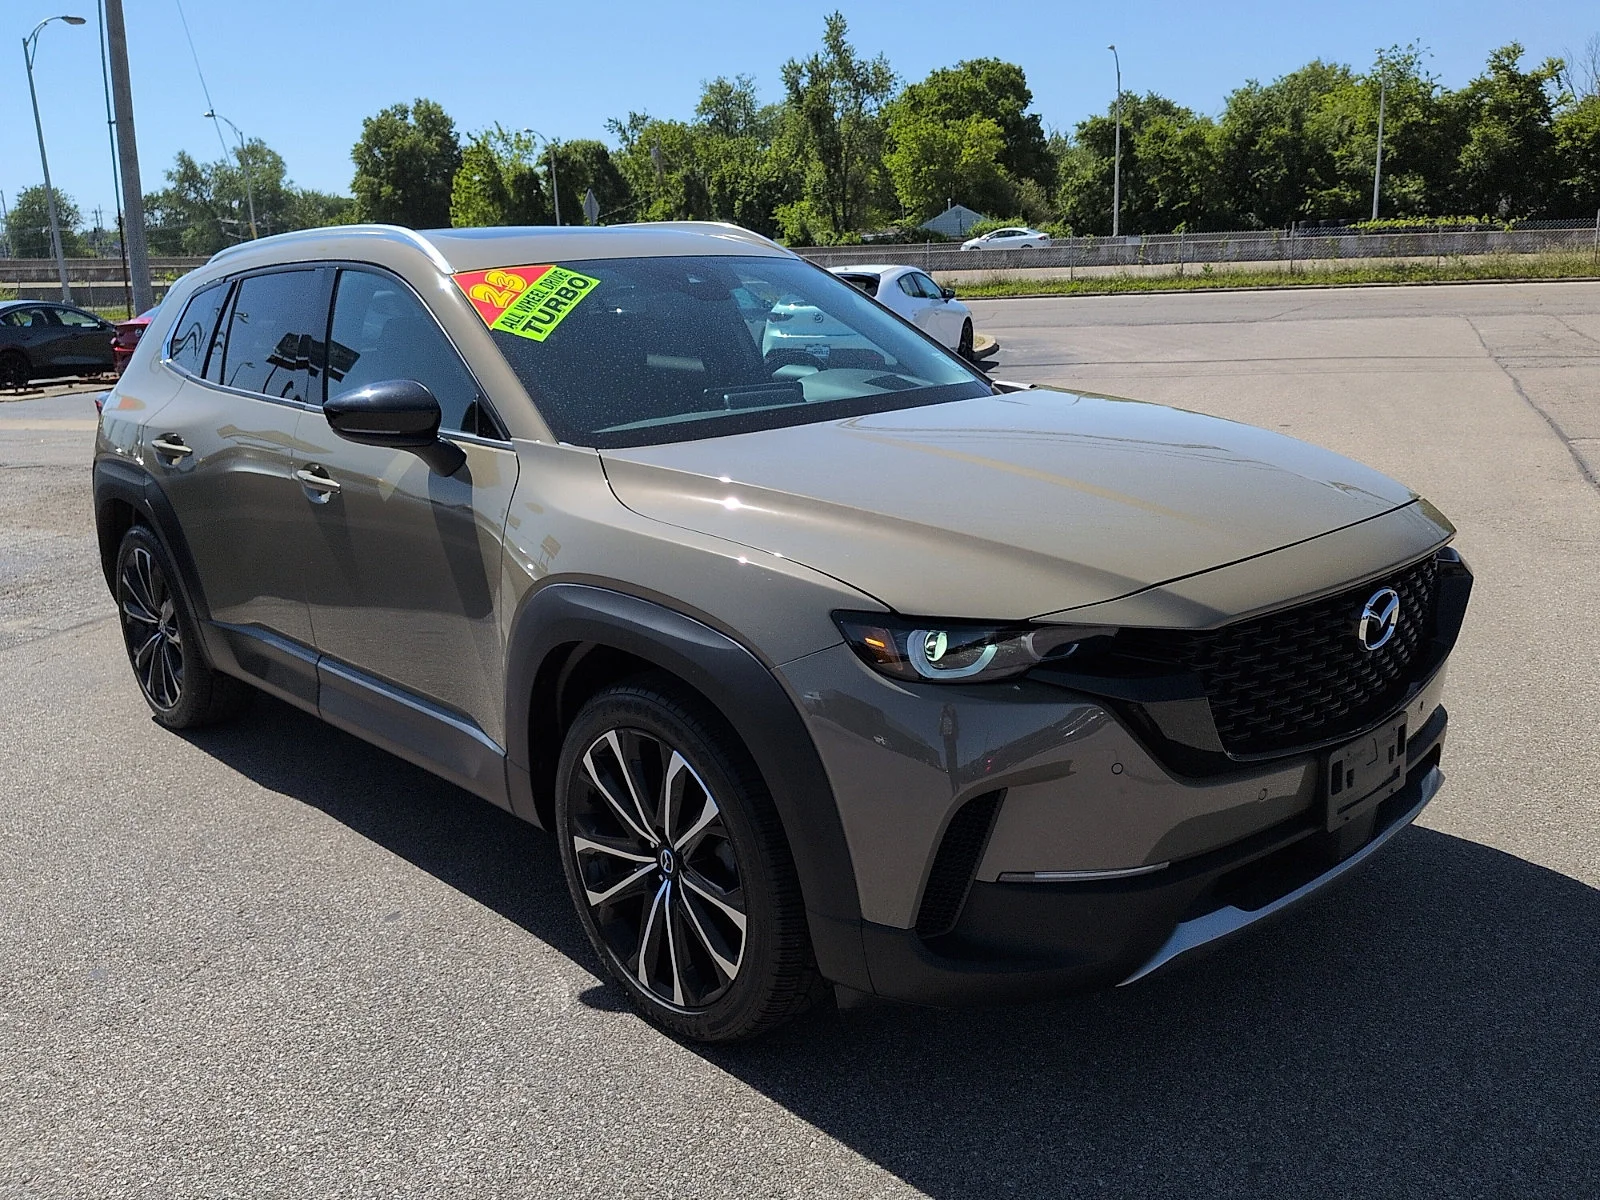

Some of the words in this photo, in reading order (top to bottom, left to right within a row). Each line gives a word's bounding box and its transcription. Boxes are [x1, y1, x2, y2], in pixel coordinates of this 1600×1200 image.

[469, 270, 528, 309] 23
[501, 313, 526, 330] ALL
[514, 289, 549, 313] WHEEL
[539, 270, 570, 290] DRIVE
[521, 276, 591, 335] TURBO
